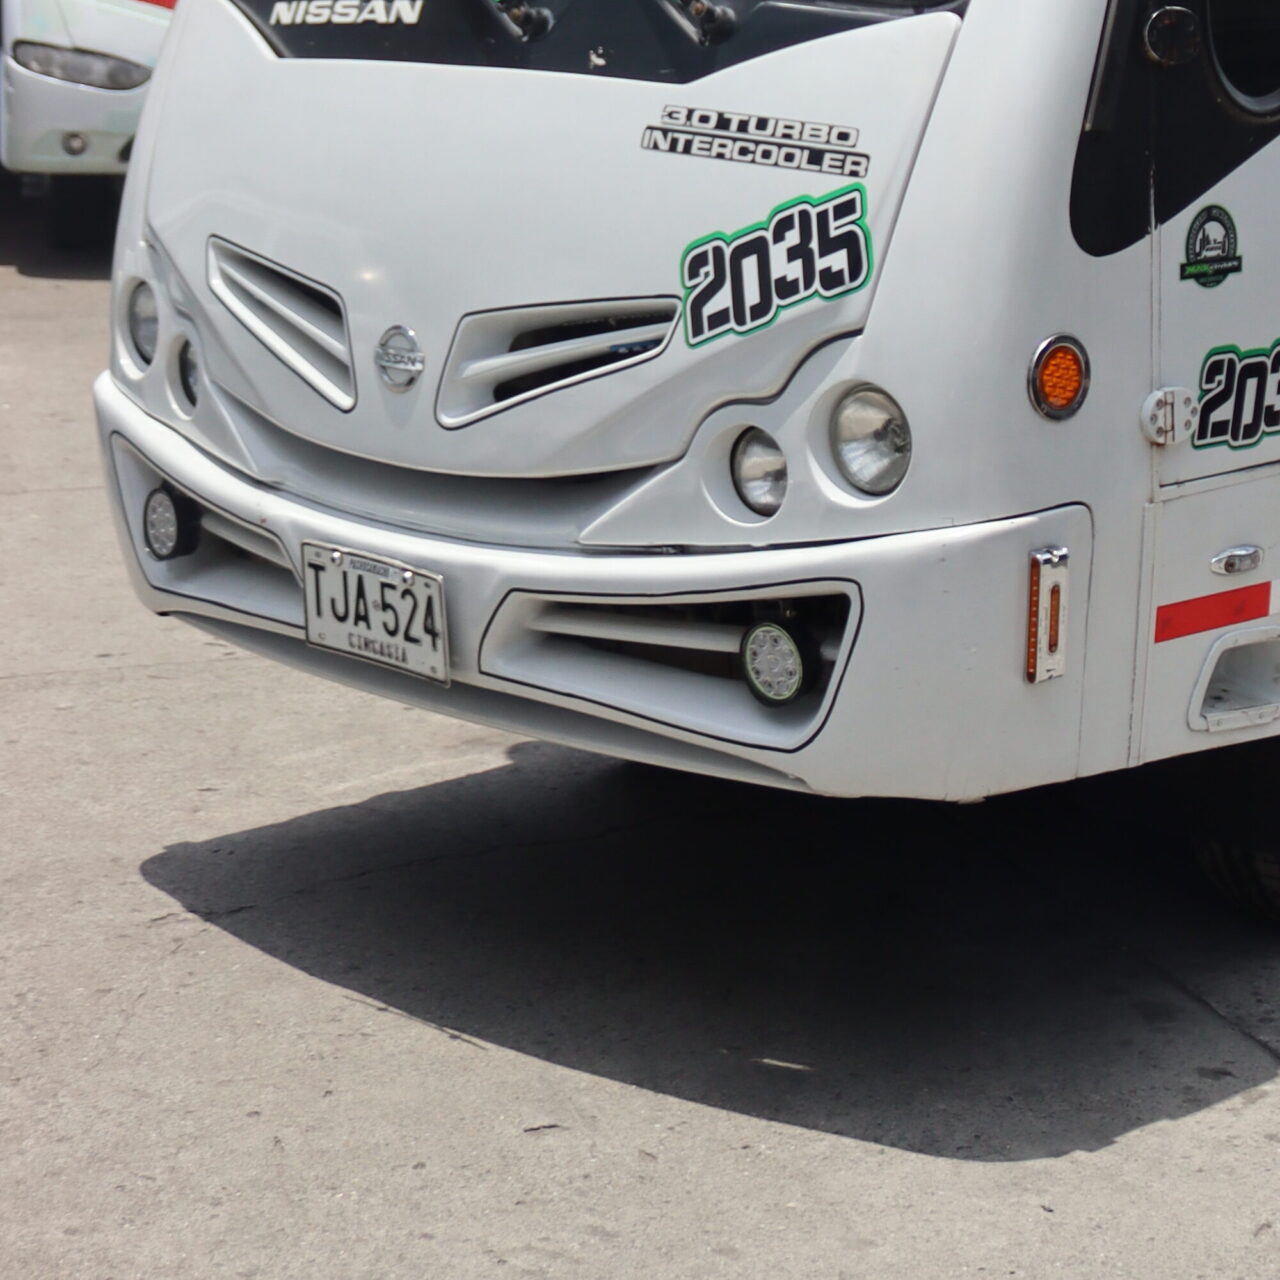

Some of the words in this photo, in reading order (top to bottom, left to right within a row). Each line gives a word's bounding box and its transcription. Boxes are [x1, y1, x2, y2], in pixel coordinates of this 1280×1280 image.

[641, 126, 869, 177] INTERCOOLER
[723, 113, 859, 148] TURBO
[683, 187, 870, 346] 2035
[308, 561, 371, 631] TJA
[380, 581, 440, 652] 524
